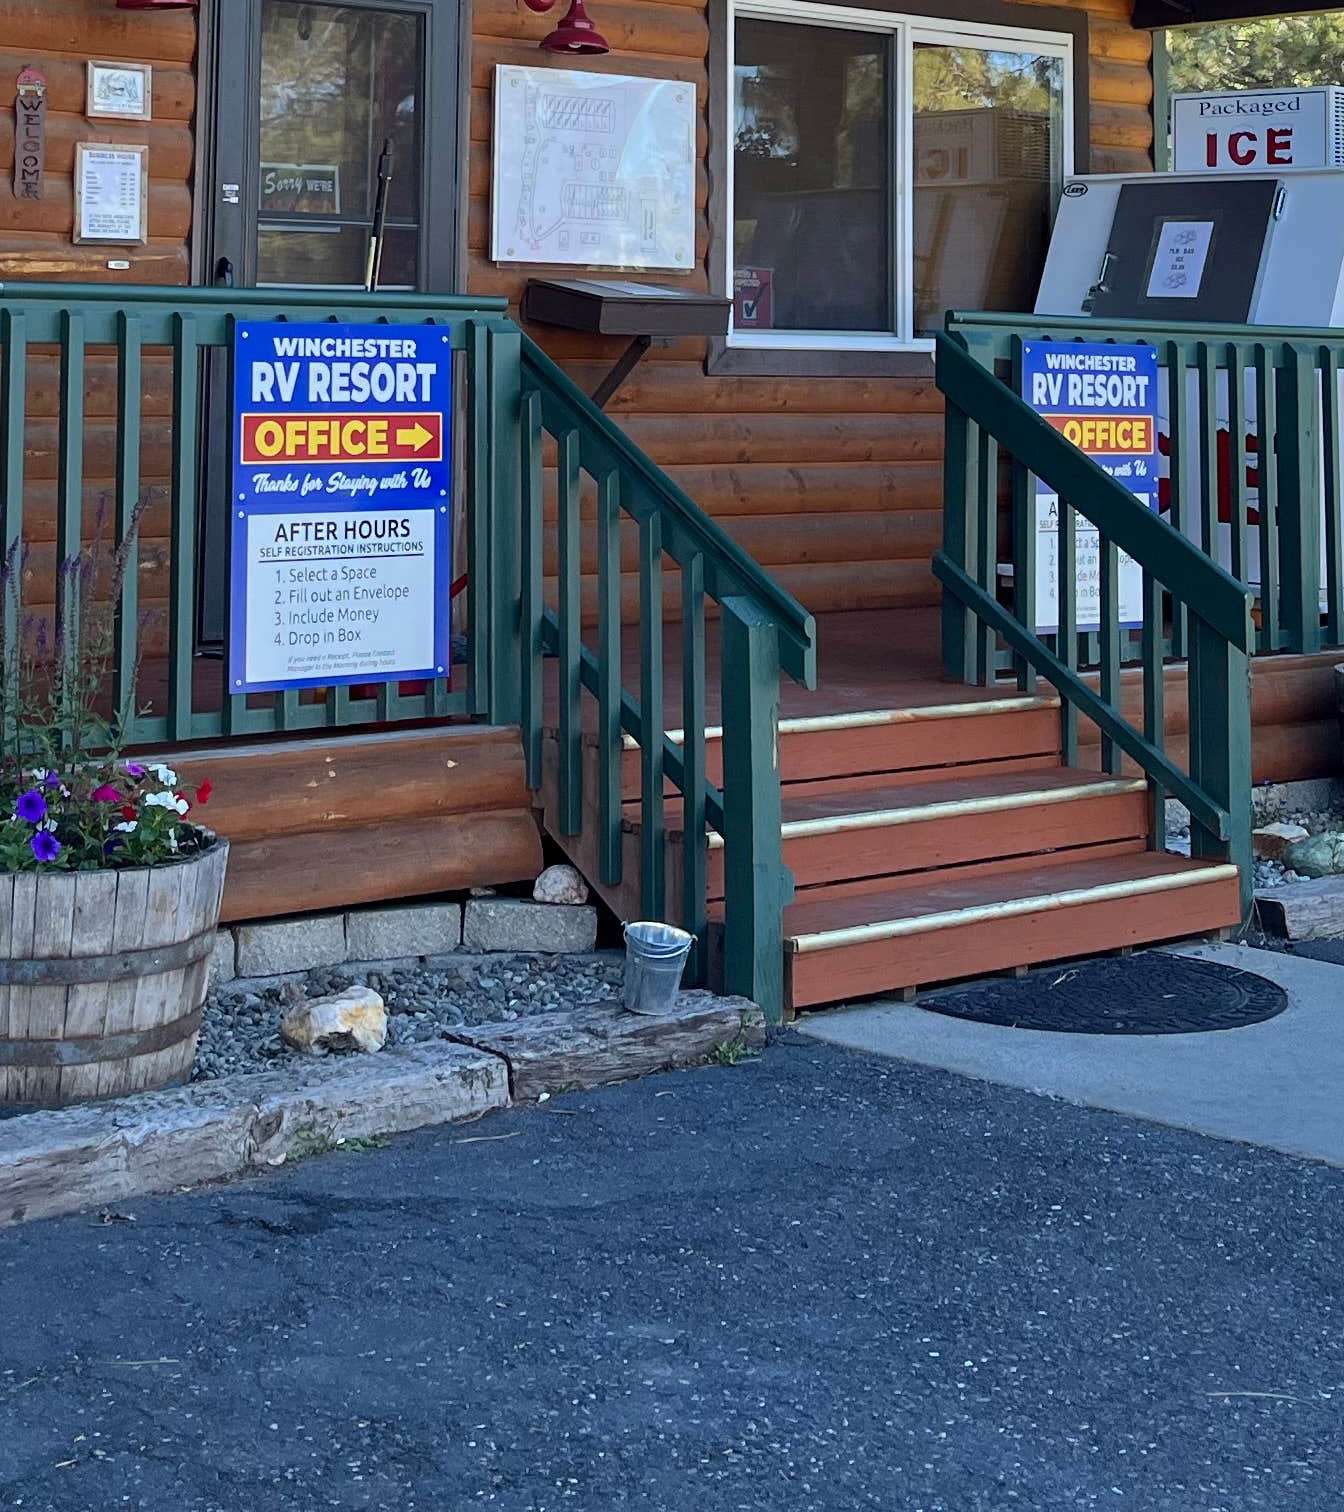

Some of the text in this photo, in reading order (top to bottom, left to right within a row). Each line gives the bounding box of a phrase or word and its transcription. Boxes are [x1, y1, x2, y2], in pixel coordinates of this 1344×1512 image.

[1199, 96, 1301, 116] Packaged
[19, 97, 43, 196] WELCOME
[1206, 126, 1293, 168] ICE
[264, 172, 303, 194] Sorry
[273, 337, 417, 358] WINCHESTER
[1045, 354, 1136, 372] WINCHESTER
[252, 361, 437, 403] RV RESORT
[1033, 372, 1149, 407] RV RESORT
[255, 420, 389, 457] OFFICE
[1063, 420, 1146, 449] OFFICE
[252, 467, 432, 497] Thanks for Staying with Us
[275, 519, 411, 542] AFTER HOURS
[260, 540, 424, 558] SELF REGISTRATION INSTRUCTIONS
[275, 566, 377, 584] 1. Select a Space
[274, 583, 410, 605] 2. Fill out an Envelope
[274, 607, 380, 626] 3. Include Money
[274, 628, 362, 647] 4. Drop in Box
